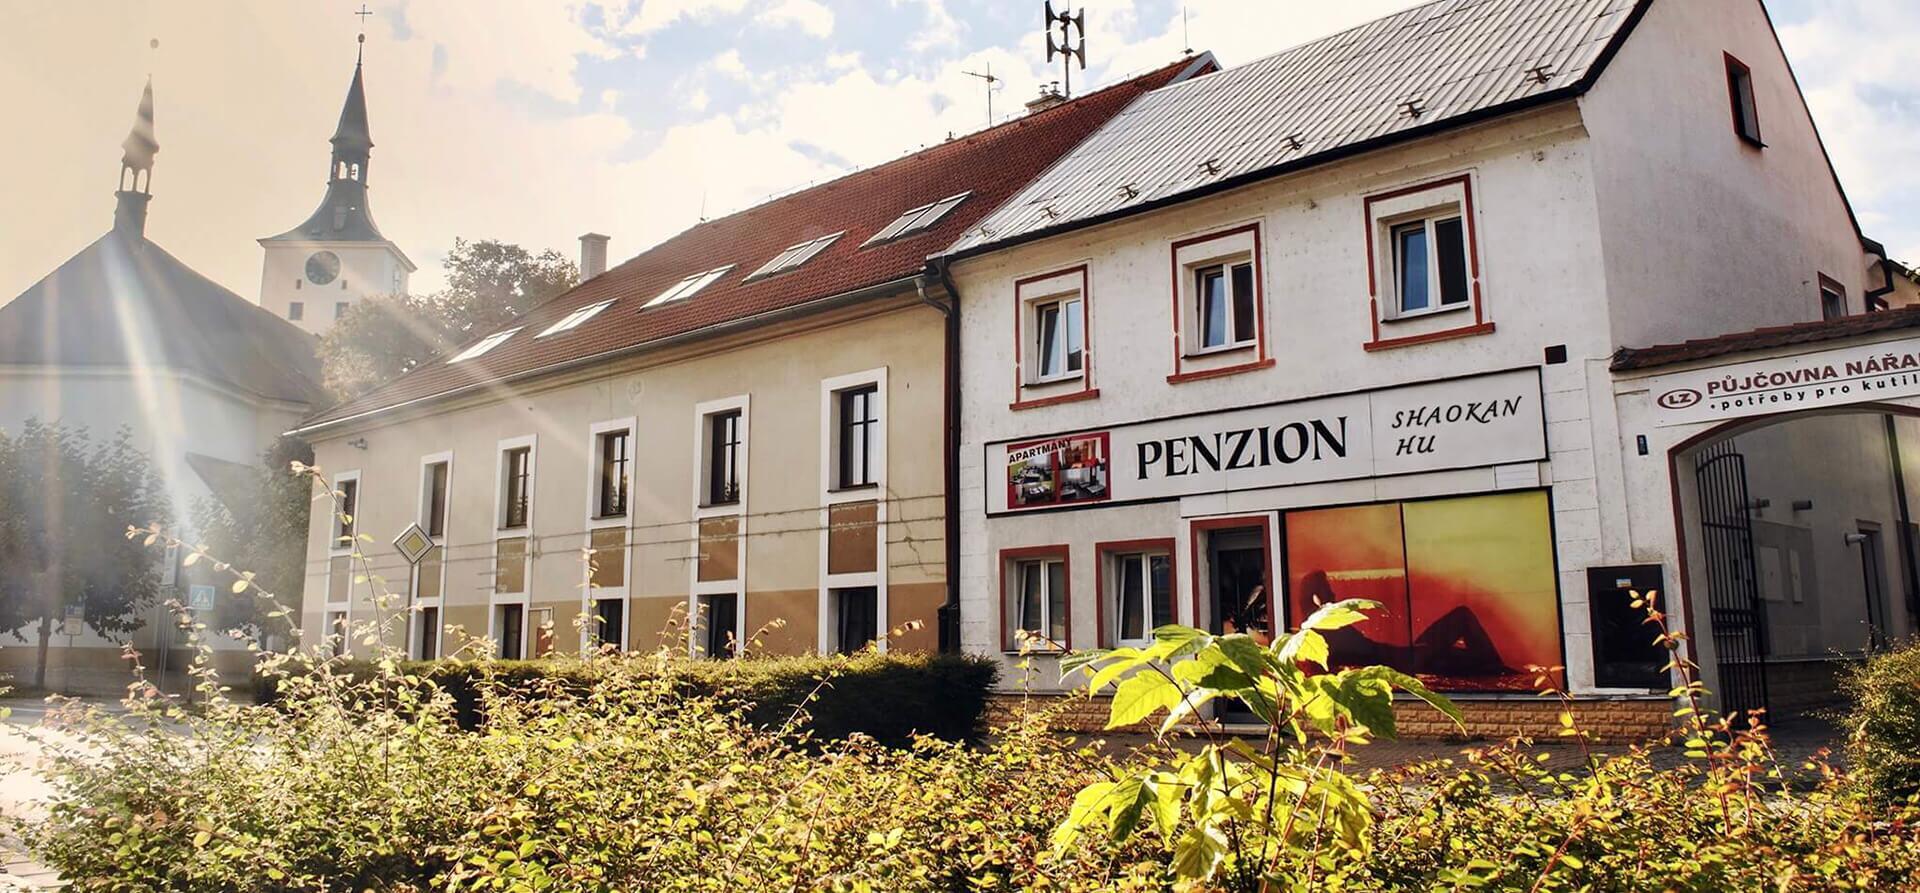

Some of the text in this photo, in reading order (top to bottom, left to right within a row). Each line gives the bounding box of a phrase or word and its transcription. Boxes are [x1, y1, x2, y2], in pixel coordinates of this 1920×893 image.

[1707, 352, 1920, 395] PŮJČOVNA NÁŘA
[1668, 393, 1692, 405] LZ
[1722, 391, 1805, 411] potřeby
[1816, 385, 1850, 399] pro
[1391, 395, 1522, 429] SHAOKAN
[1009, 437, 1072, 464] APARTMANY
[1136, 416, 1348, 480] PENZION
[1396, 435, 1436, 456] HU
